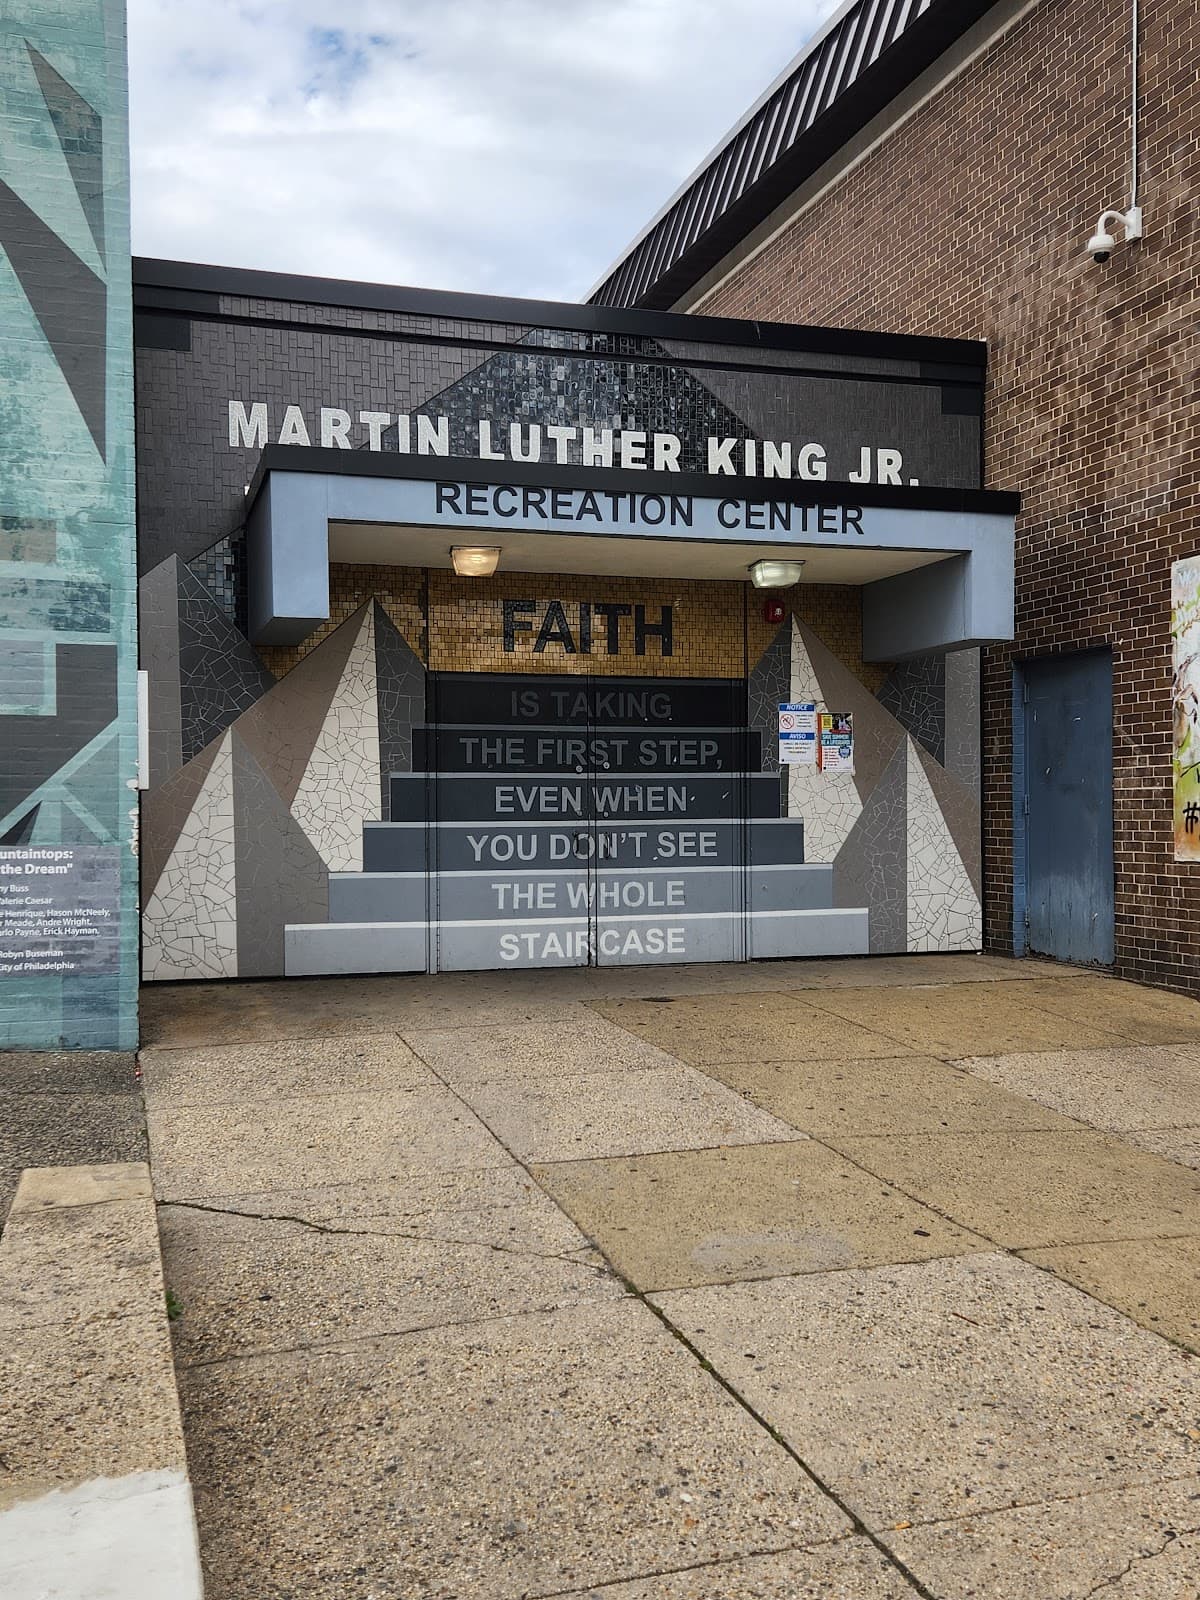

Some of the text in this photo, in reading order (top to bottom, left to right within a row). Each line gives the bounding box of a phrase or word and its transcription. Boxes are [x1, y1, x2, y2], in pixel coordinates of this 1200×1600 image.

[228, 400, 919, 487] MARTIN LUTHER KING JR.
[435, 482, 865, 535] RECREATION CENTER
[503, 599, 673, 656] FAITH
[510, 690, 672, 718] IS TAKING
[458, 737, 723, 770] THE FIRST STEP,
[495, 786, 687, 813] EVEN WHEN
[467, 831, 718, 861] YOU DON'T SEE
[0, 864, 22, 875] the
[10, 884, 30, 893] Buss
[491, 880, 685, 910] THE WHOLE
[499, 927, 686, 961] STAIRCASE
[24, 962, 75, 972] Philadelphia
